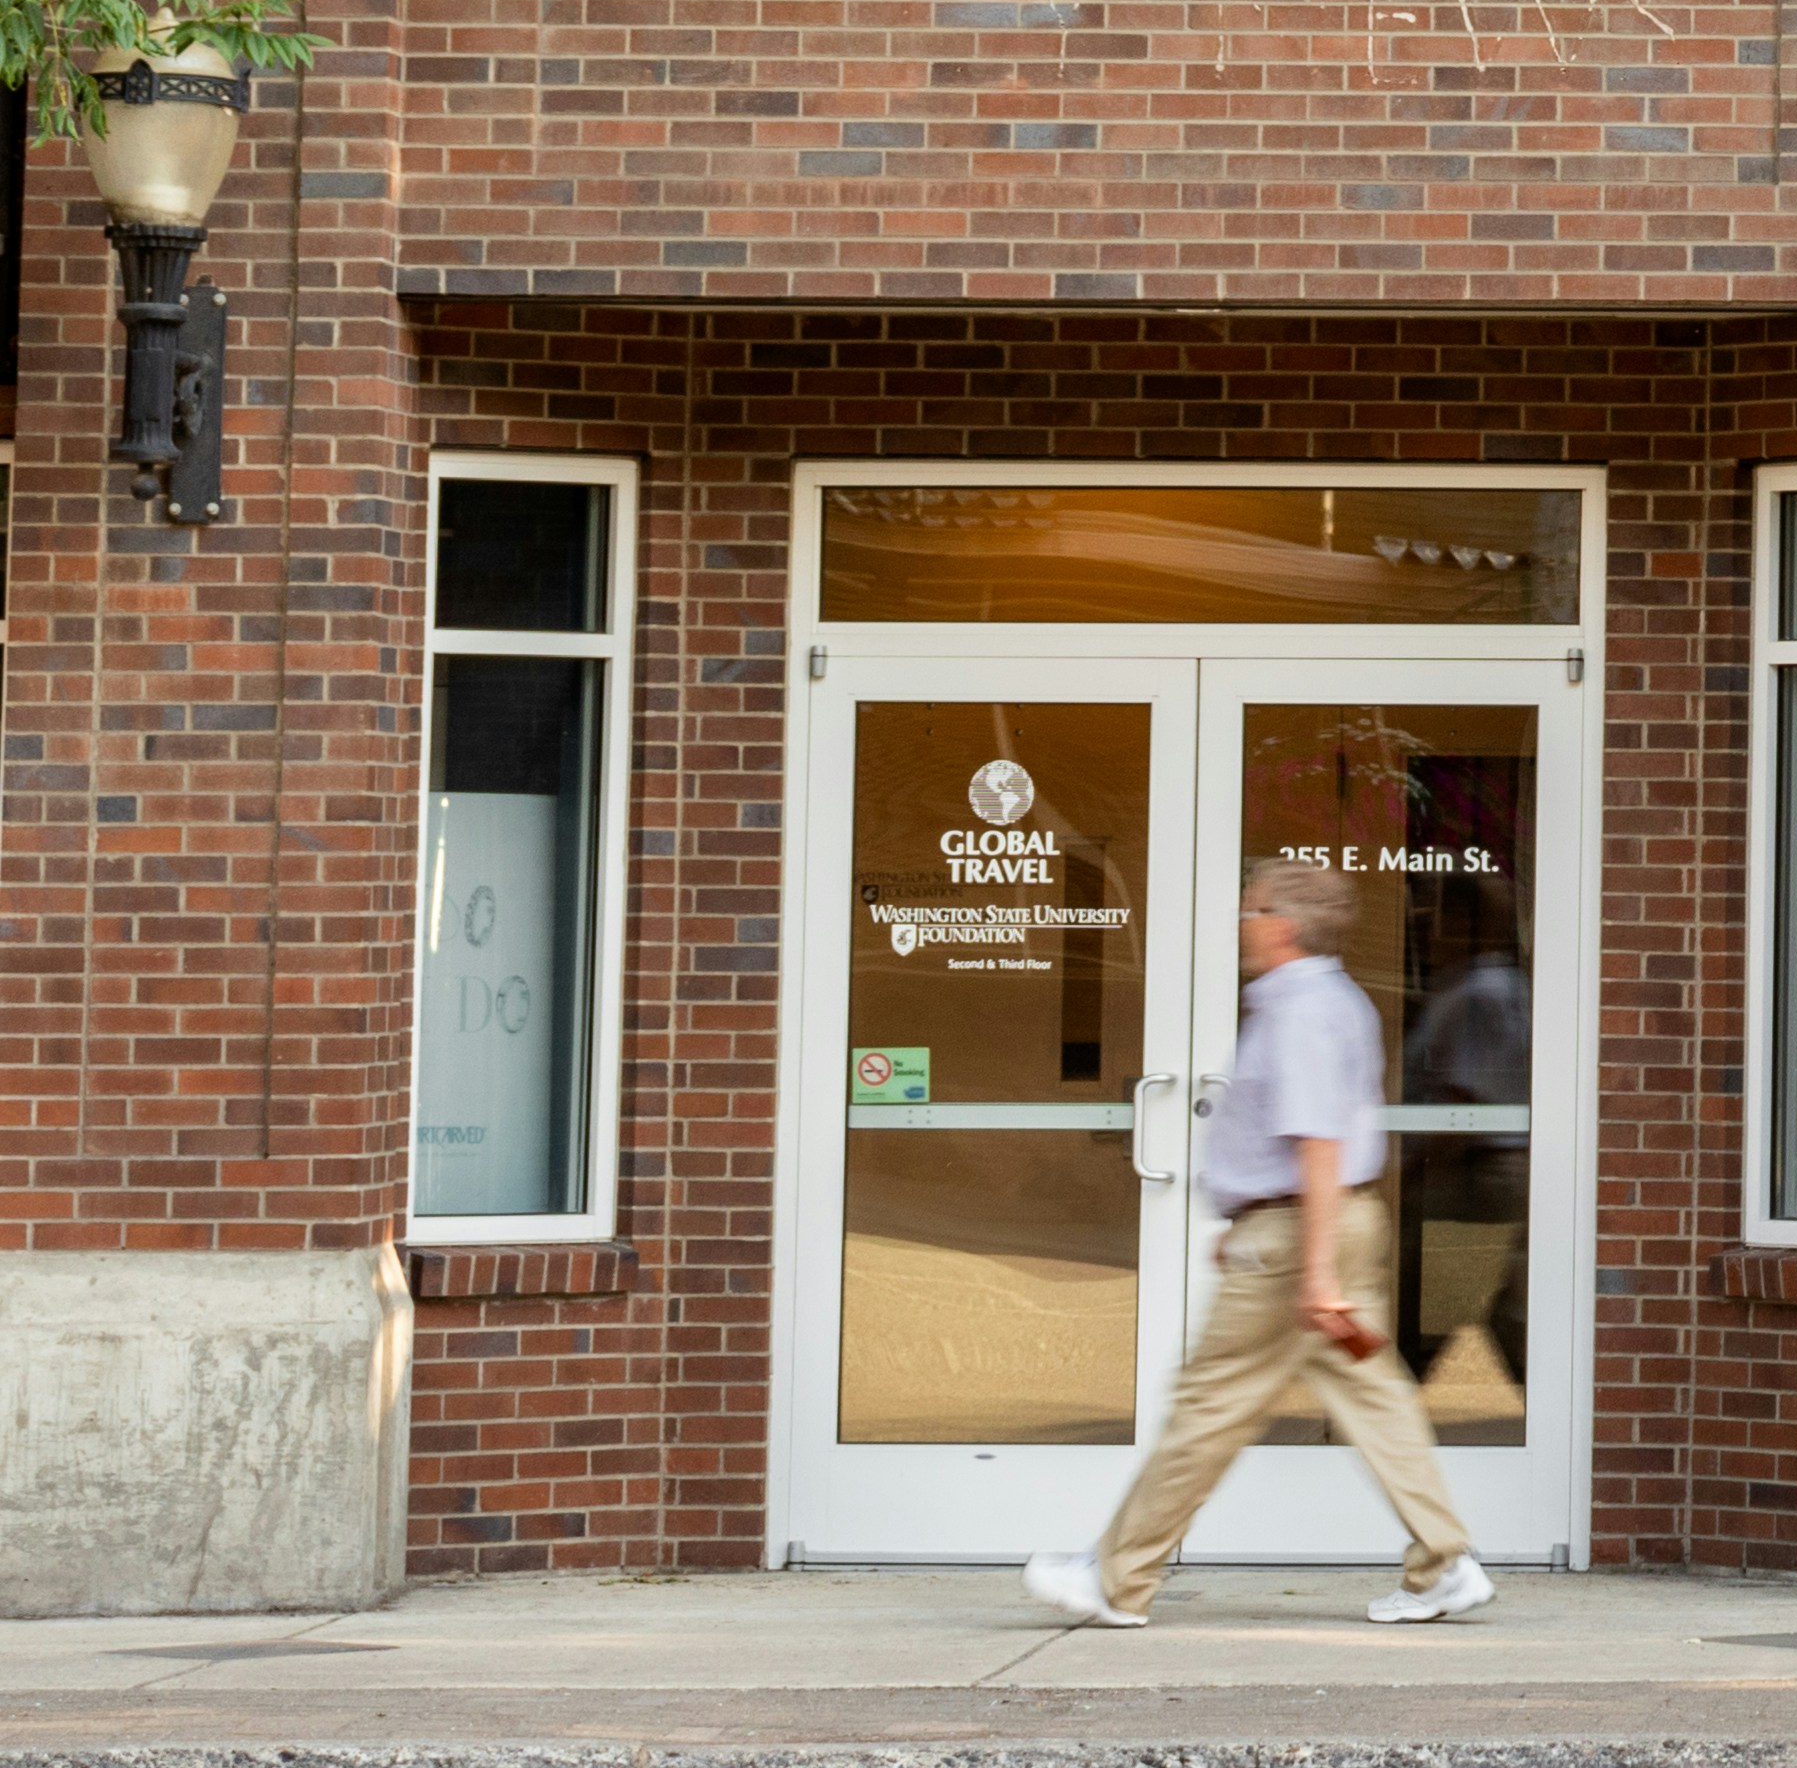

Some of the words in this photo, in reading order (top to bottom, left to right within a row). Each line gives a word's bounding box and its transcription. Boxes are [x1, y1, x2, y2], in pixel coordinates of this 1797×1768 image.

[940, 830, 1060, 856] GLOBAL
[1342, 846, 1368, 871] E.
[1379, 846, 1453, 871] Main
[1463, 846, 1500, 872] St.
[946, 858, 1054, 883] TRAVEL
[870, 905, 983, 924] WASHINGTON
[985, 905, 1031, 924] STATE
[1034, 905, 1130, 924] UNIVERSITY
[918, 927, 1025, 947] FOUNDATION
[948, 958, 984, 970] Second
[998, 958, 1024, 970] Third
[1026, 959, 1052, 970] Floor
